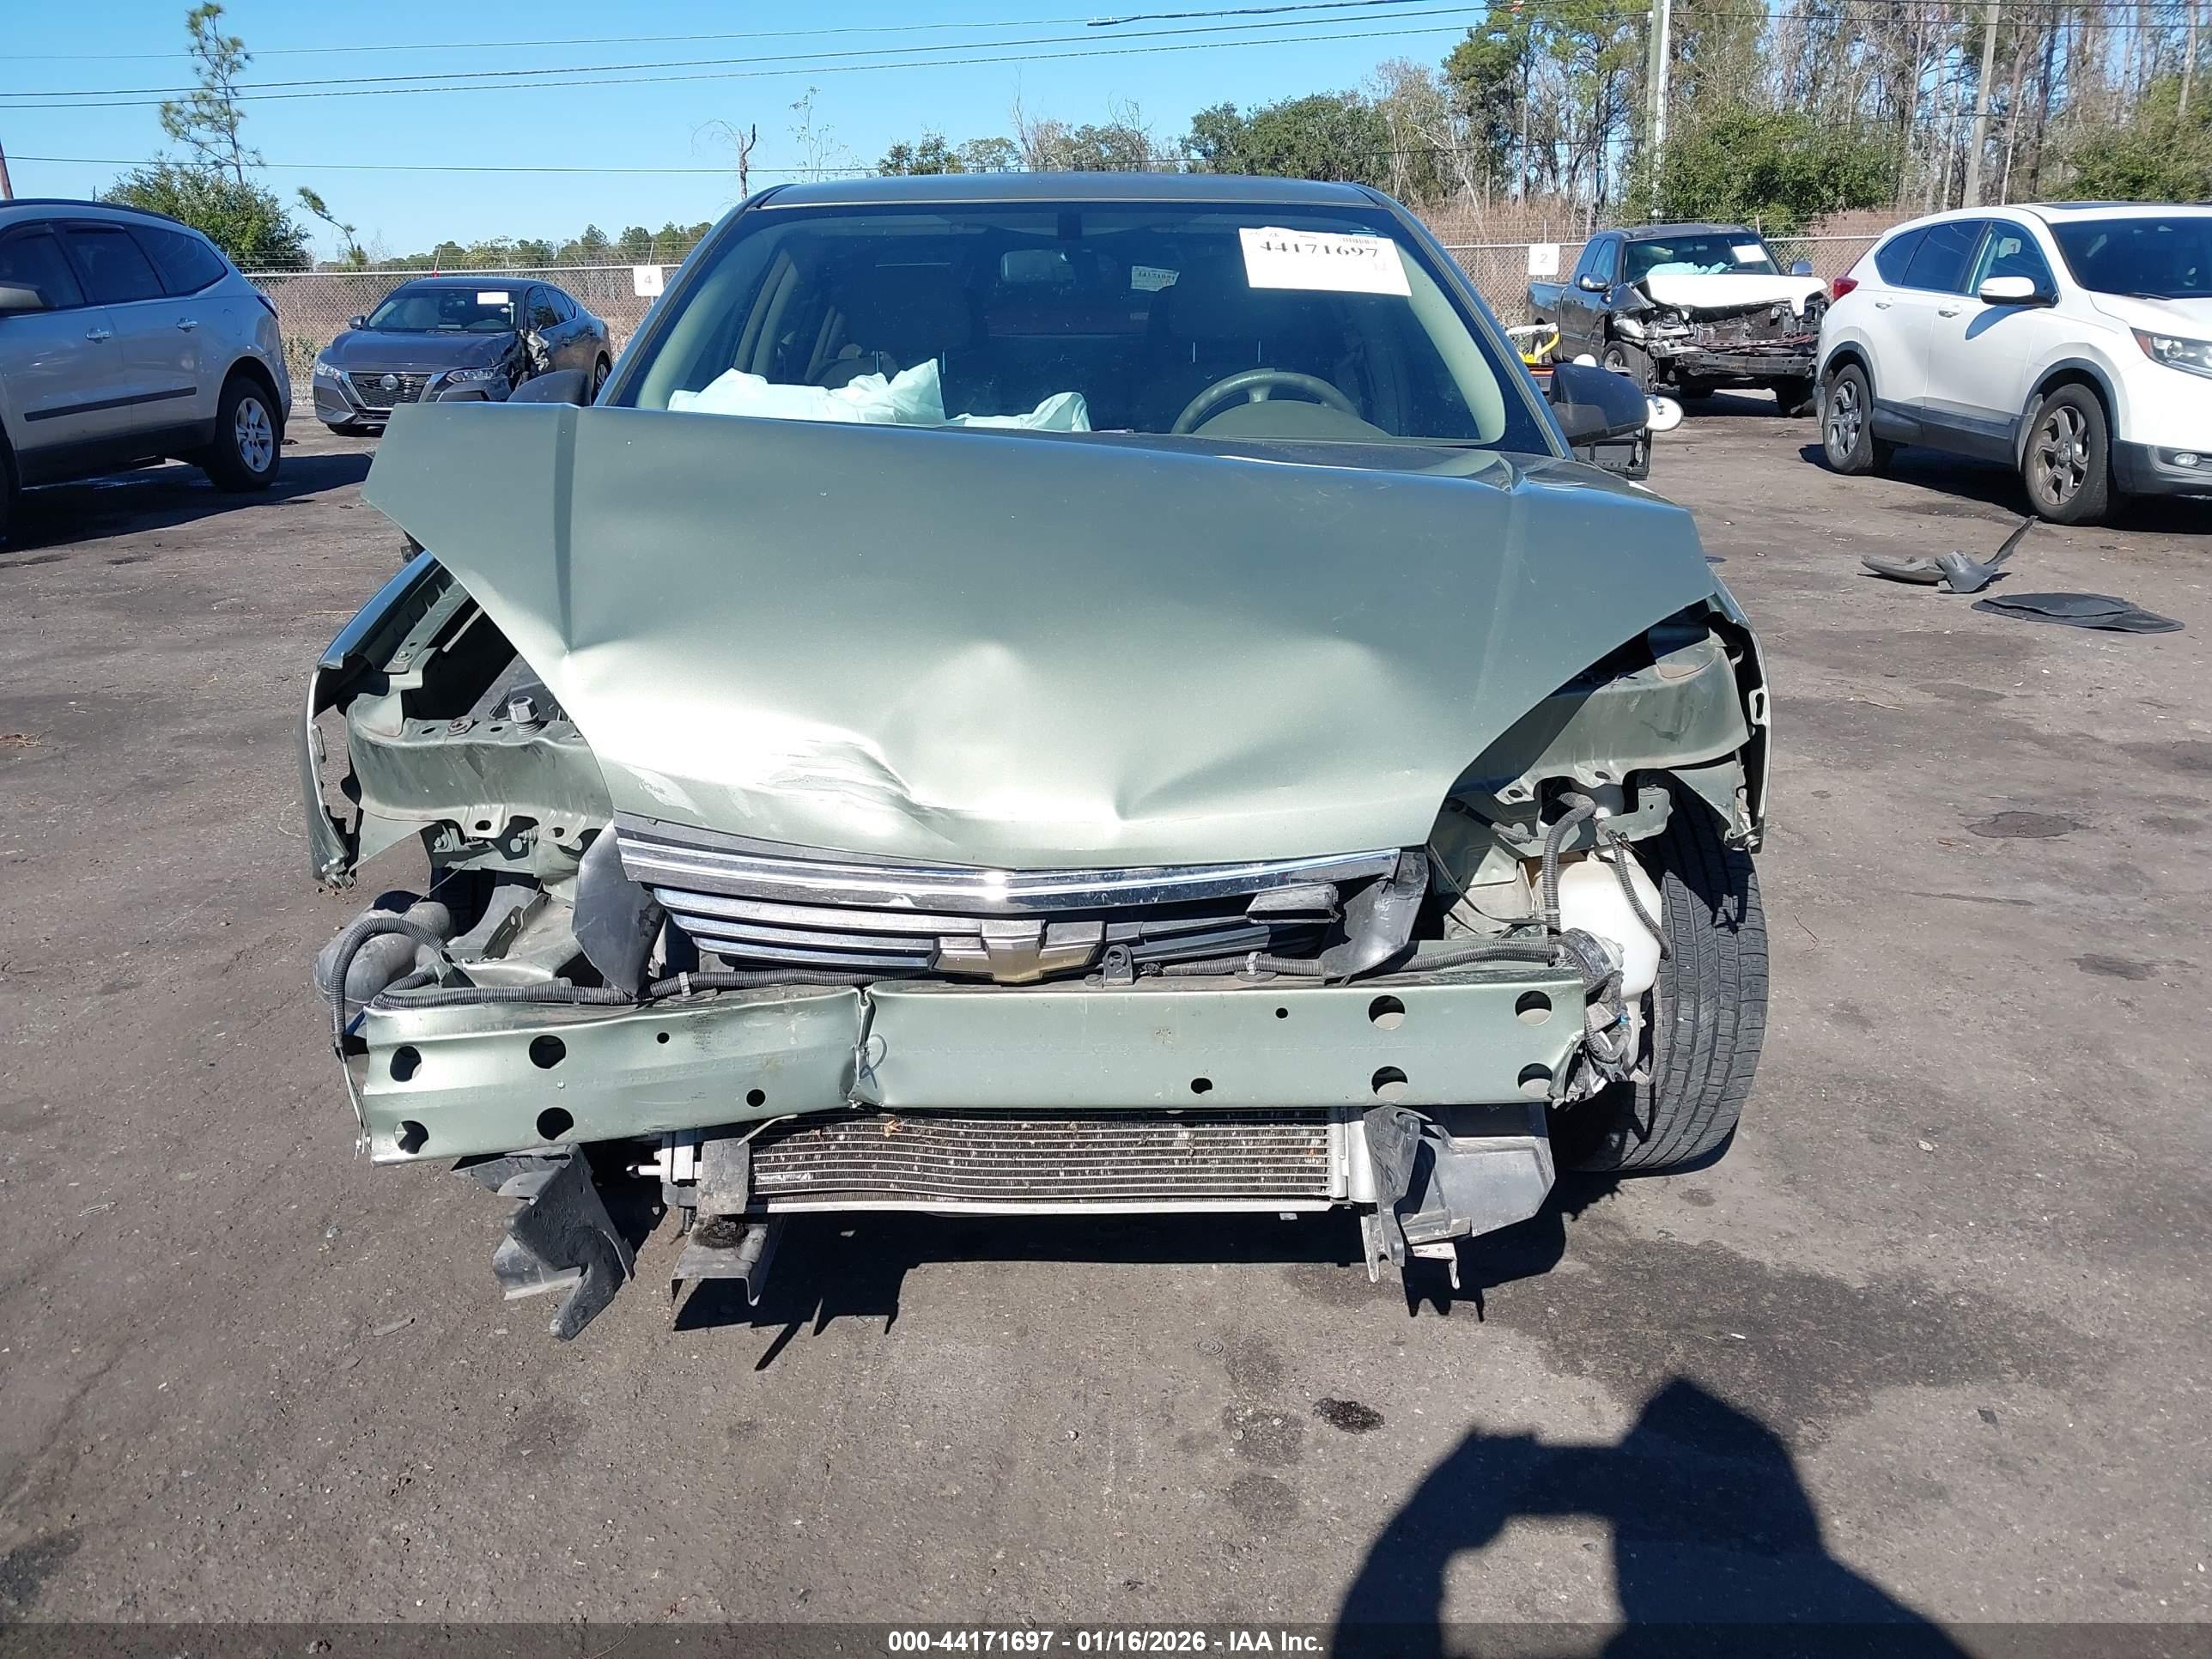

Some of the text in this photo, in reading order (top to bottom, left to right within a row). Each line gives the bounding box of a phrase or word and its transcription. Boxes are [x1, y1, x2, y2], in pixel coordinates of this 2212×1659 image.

[1260, 240, 1378, 258] 44171697
[1540, 253, 1548, 264] 2
[644, 275, 653, 285] 4
